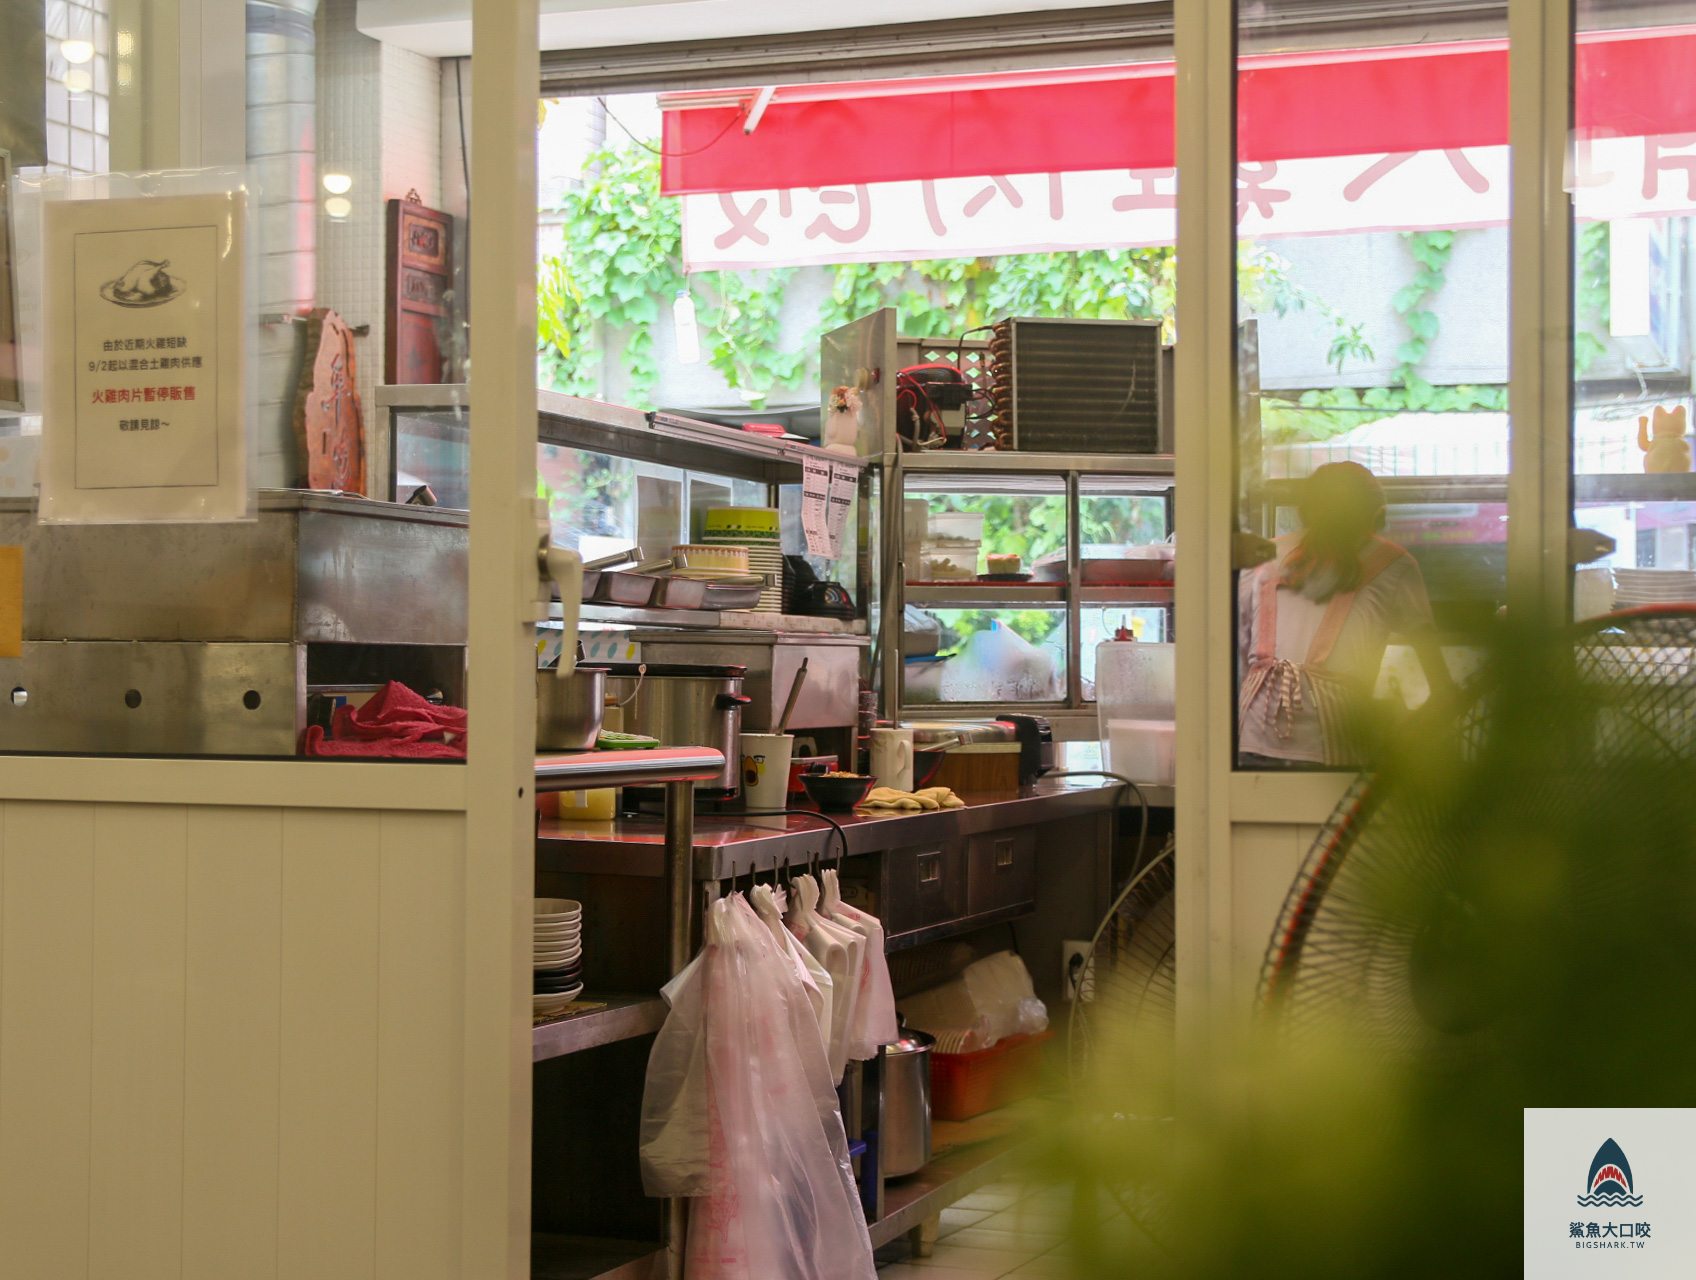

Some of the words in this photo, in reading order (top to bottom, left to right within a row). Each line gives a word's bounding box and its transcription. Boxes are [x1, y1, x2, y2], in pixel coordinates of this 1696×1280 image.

[92, 386, 196, 404] 火雞肉片暫停販售
